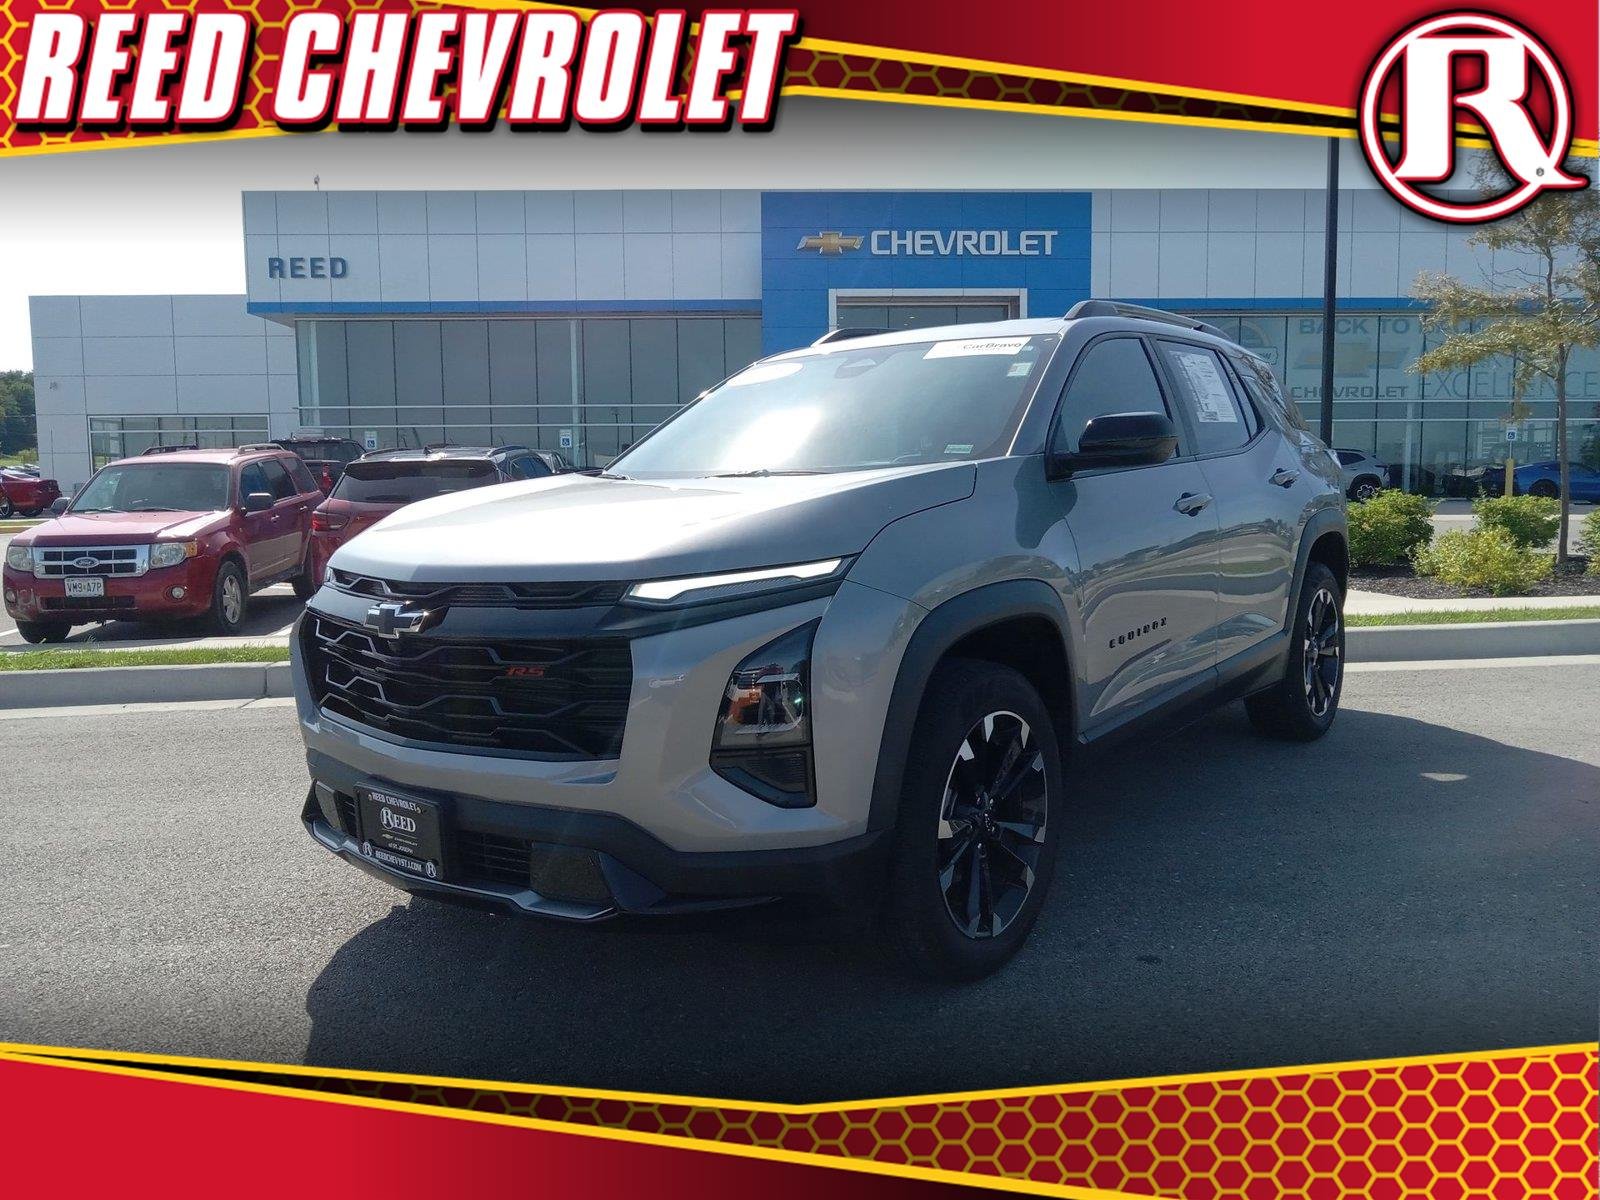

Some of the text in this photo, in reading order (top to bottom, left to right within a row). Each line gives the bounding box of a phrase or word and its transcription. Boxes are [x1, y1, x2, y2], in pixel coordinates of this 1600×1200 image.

[870, 230, 1058, 255] CHEVROLET
[268, 257, 348, 279] REED
[1300, 318, 1369, 334] BCK
[1291, 386, 1409, 398] CHVROLET
[506, 666, 545, 677] RS
